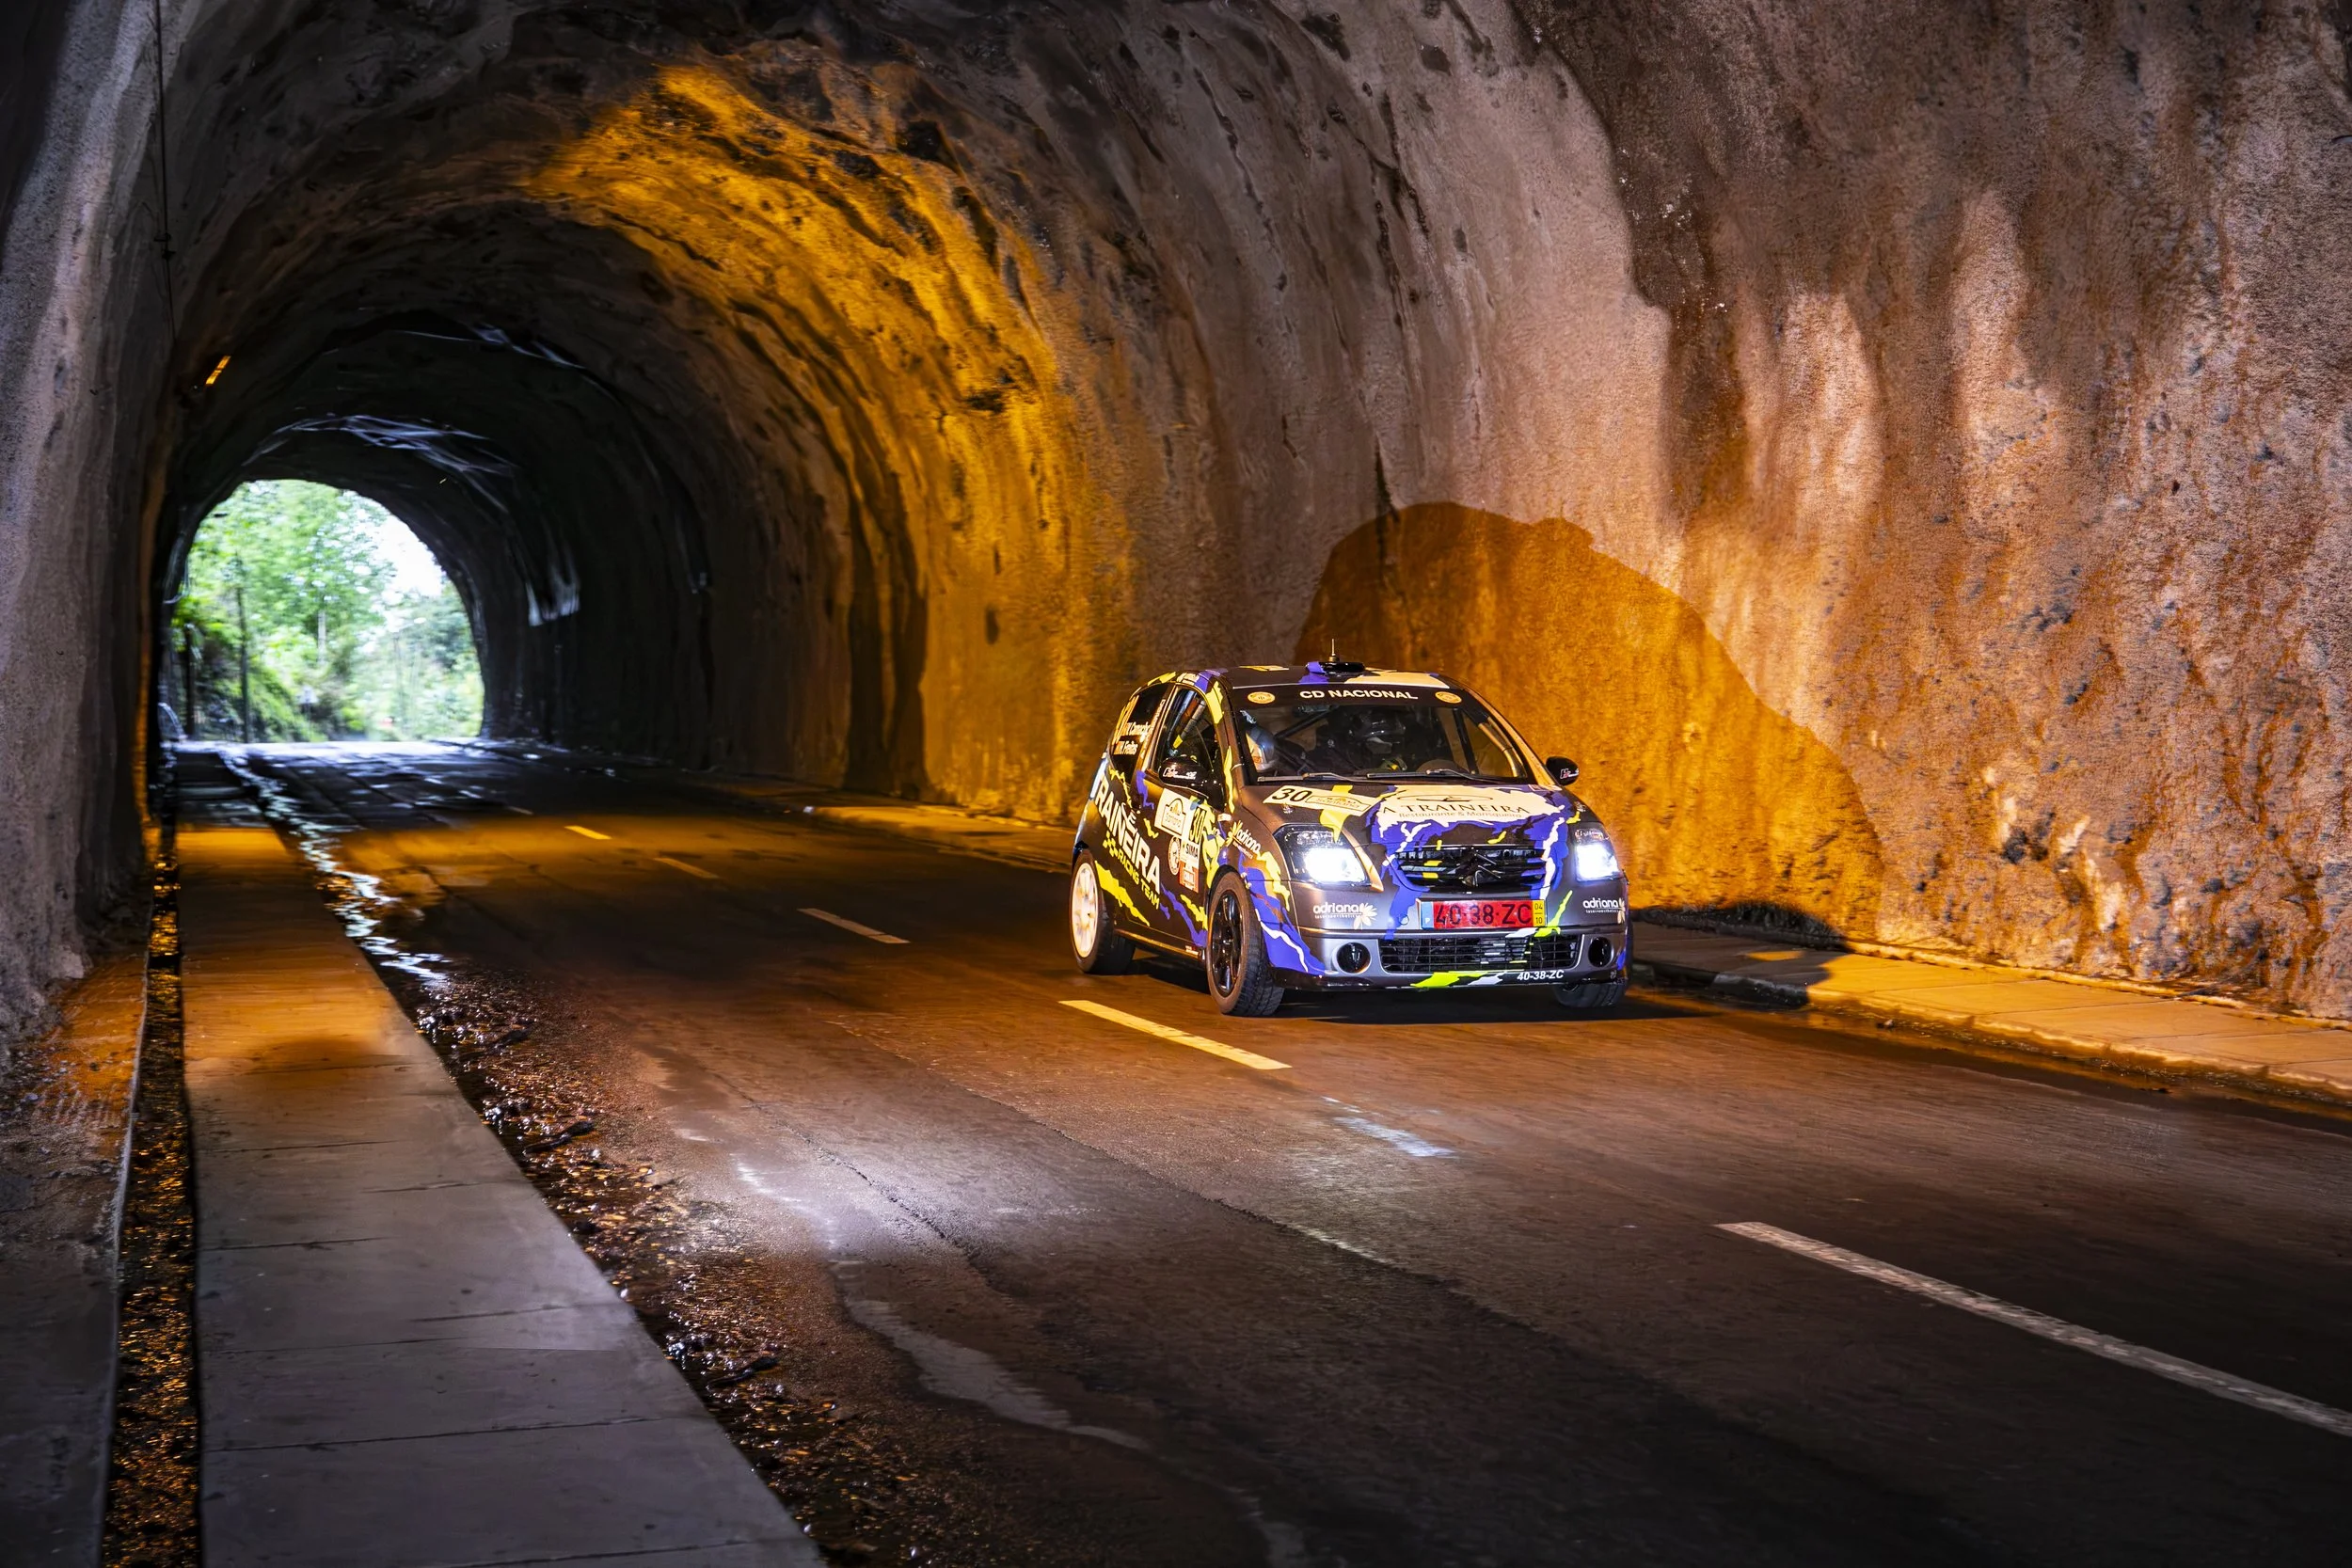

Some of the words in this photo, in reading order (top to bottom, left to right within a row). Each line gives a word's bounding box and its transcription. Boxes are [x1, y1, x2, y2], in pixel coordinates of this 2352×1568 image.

[1299, 690, 1326, 699] CD
[1327, 689, 1419, 700] NACIONAL
[1272, 788, 1312, 801] 30
[1400, 803, 1531, 815] TRAINEIRA
[1189, 806, 1207, 846] 30
[1236, 829, 1262, 854] adriana
[1117, 847, 1140, 885] RACING
[1140, 879, 1161, 910] TEAM
[1312, 902, 1359, 915] adriana
[1582, 897, 1619, 909] adriana
[1517, 970, 1565, 981] 40-38-ZC
